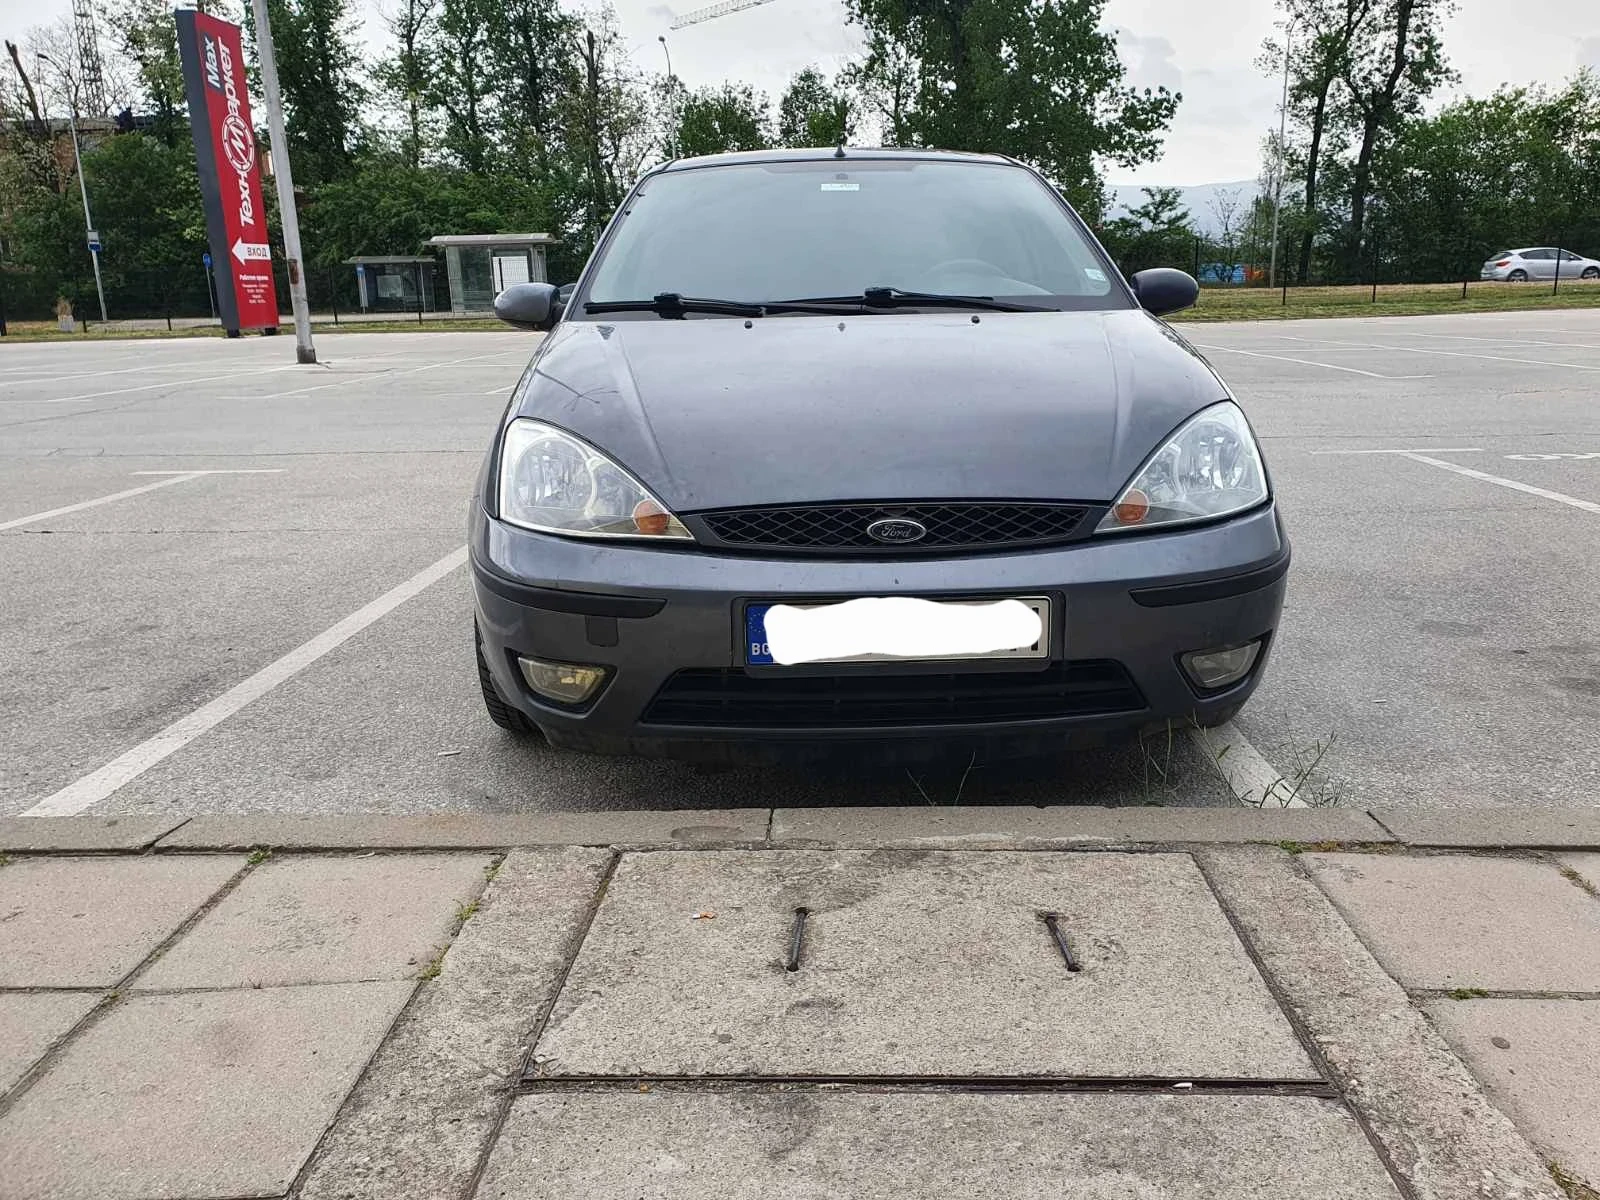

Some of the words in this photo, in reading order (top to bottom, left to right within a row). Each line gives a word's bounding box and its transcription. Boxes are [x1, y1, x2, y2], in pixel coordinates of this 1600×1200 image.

[204, 36, 221, 89] Max
[247, 247, 267, 257] ВХОД
[880, 524, 912, 538] Ford
[751, 642, 770, 656] BG
